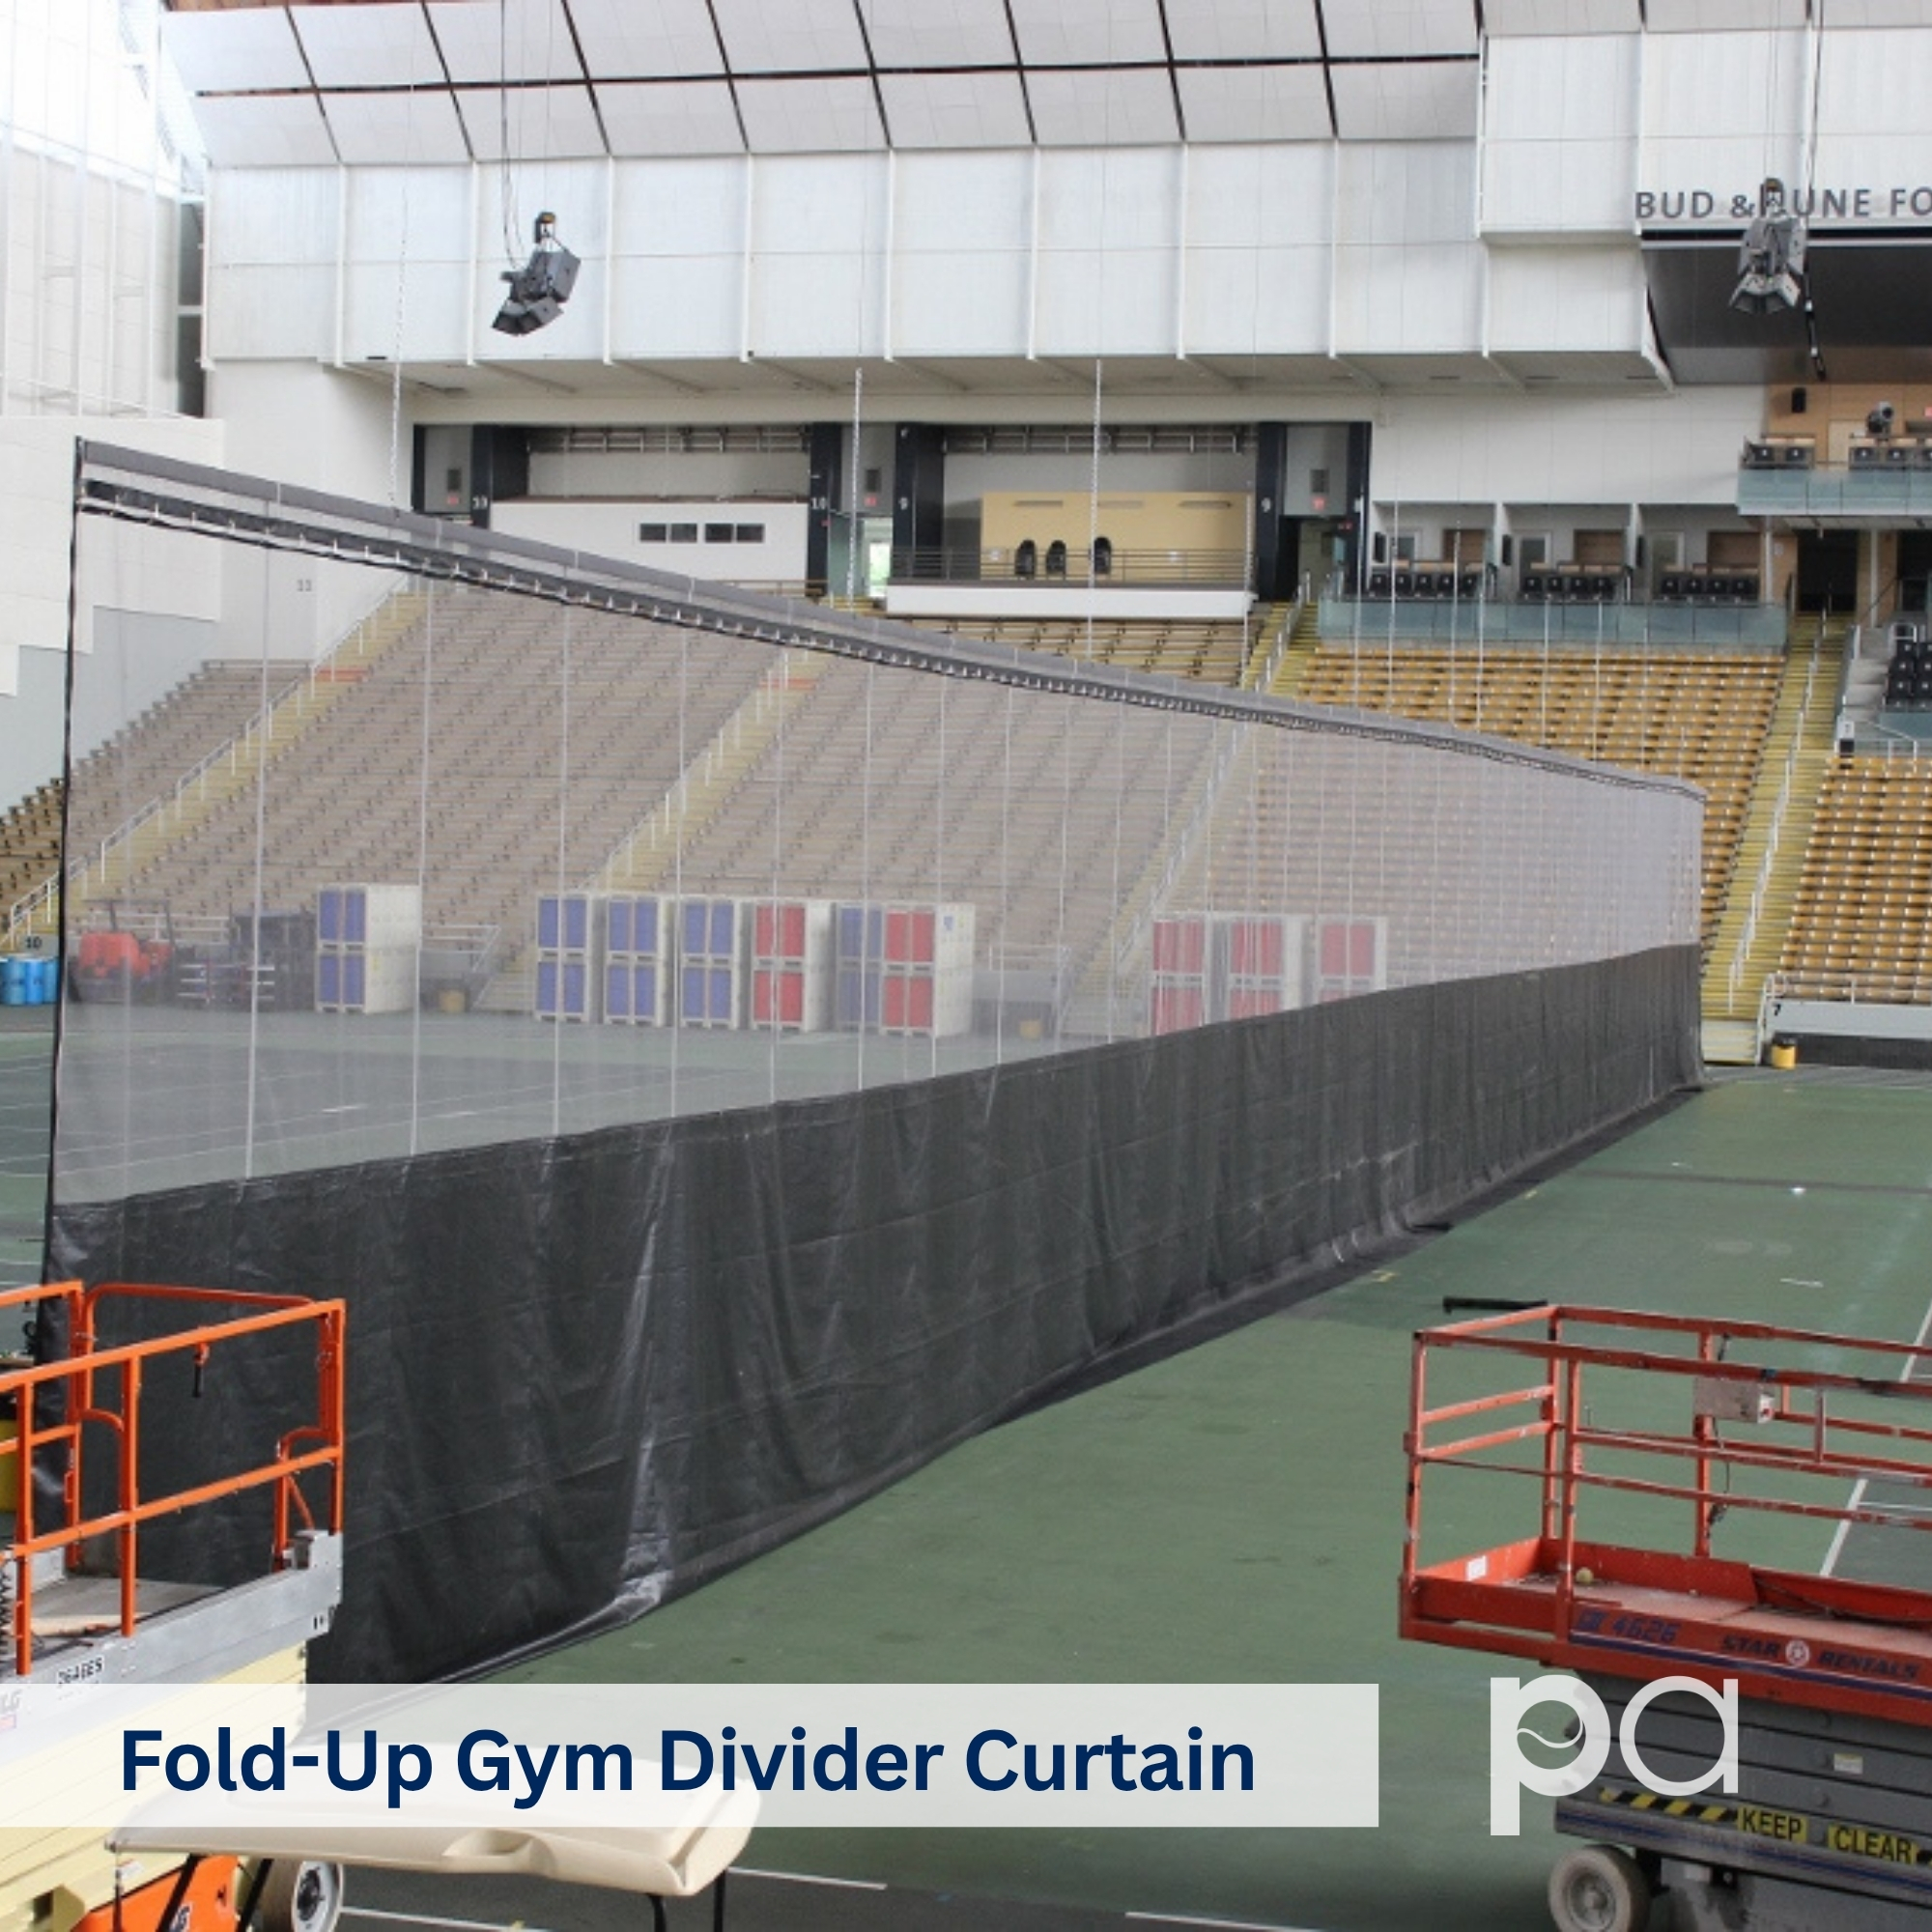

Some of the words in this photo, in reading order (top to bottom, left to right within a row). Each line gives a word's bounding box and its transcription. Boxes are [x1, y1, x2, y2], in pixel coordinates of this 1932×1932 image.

[1634, 191, 1715, 219] BUD
[1730, 194, 1755, 218] &
[1721, 1634, 1780, 1657] STAR
[1818, 1650, 1919, 1681] RENTALS
[1743, 1807, 1803, 1841] KEEP
[1835, 1825, 1912, 1863] CLEAR
